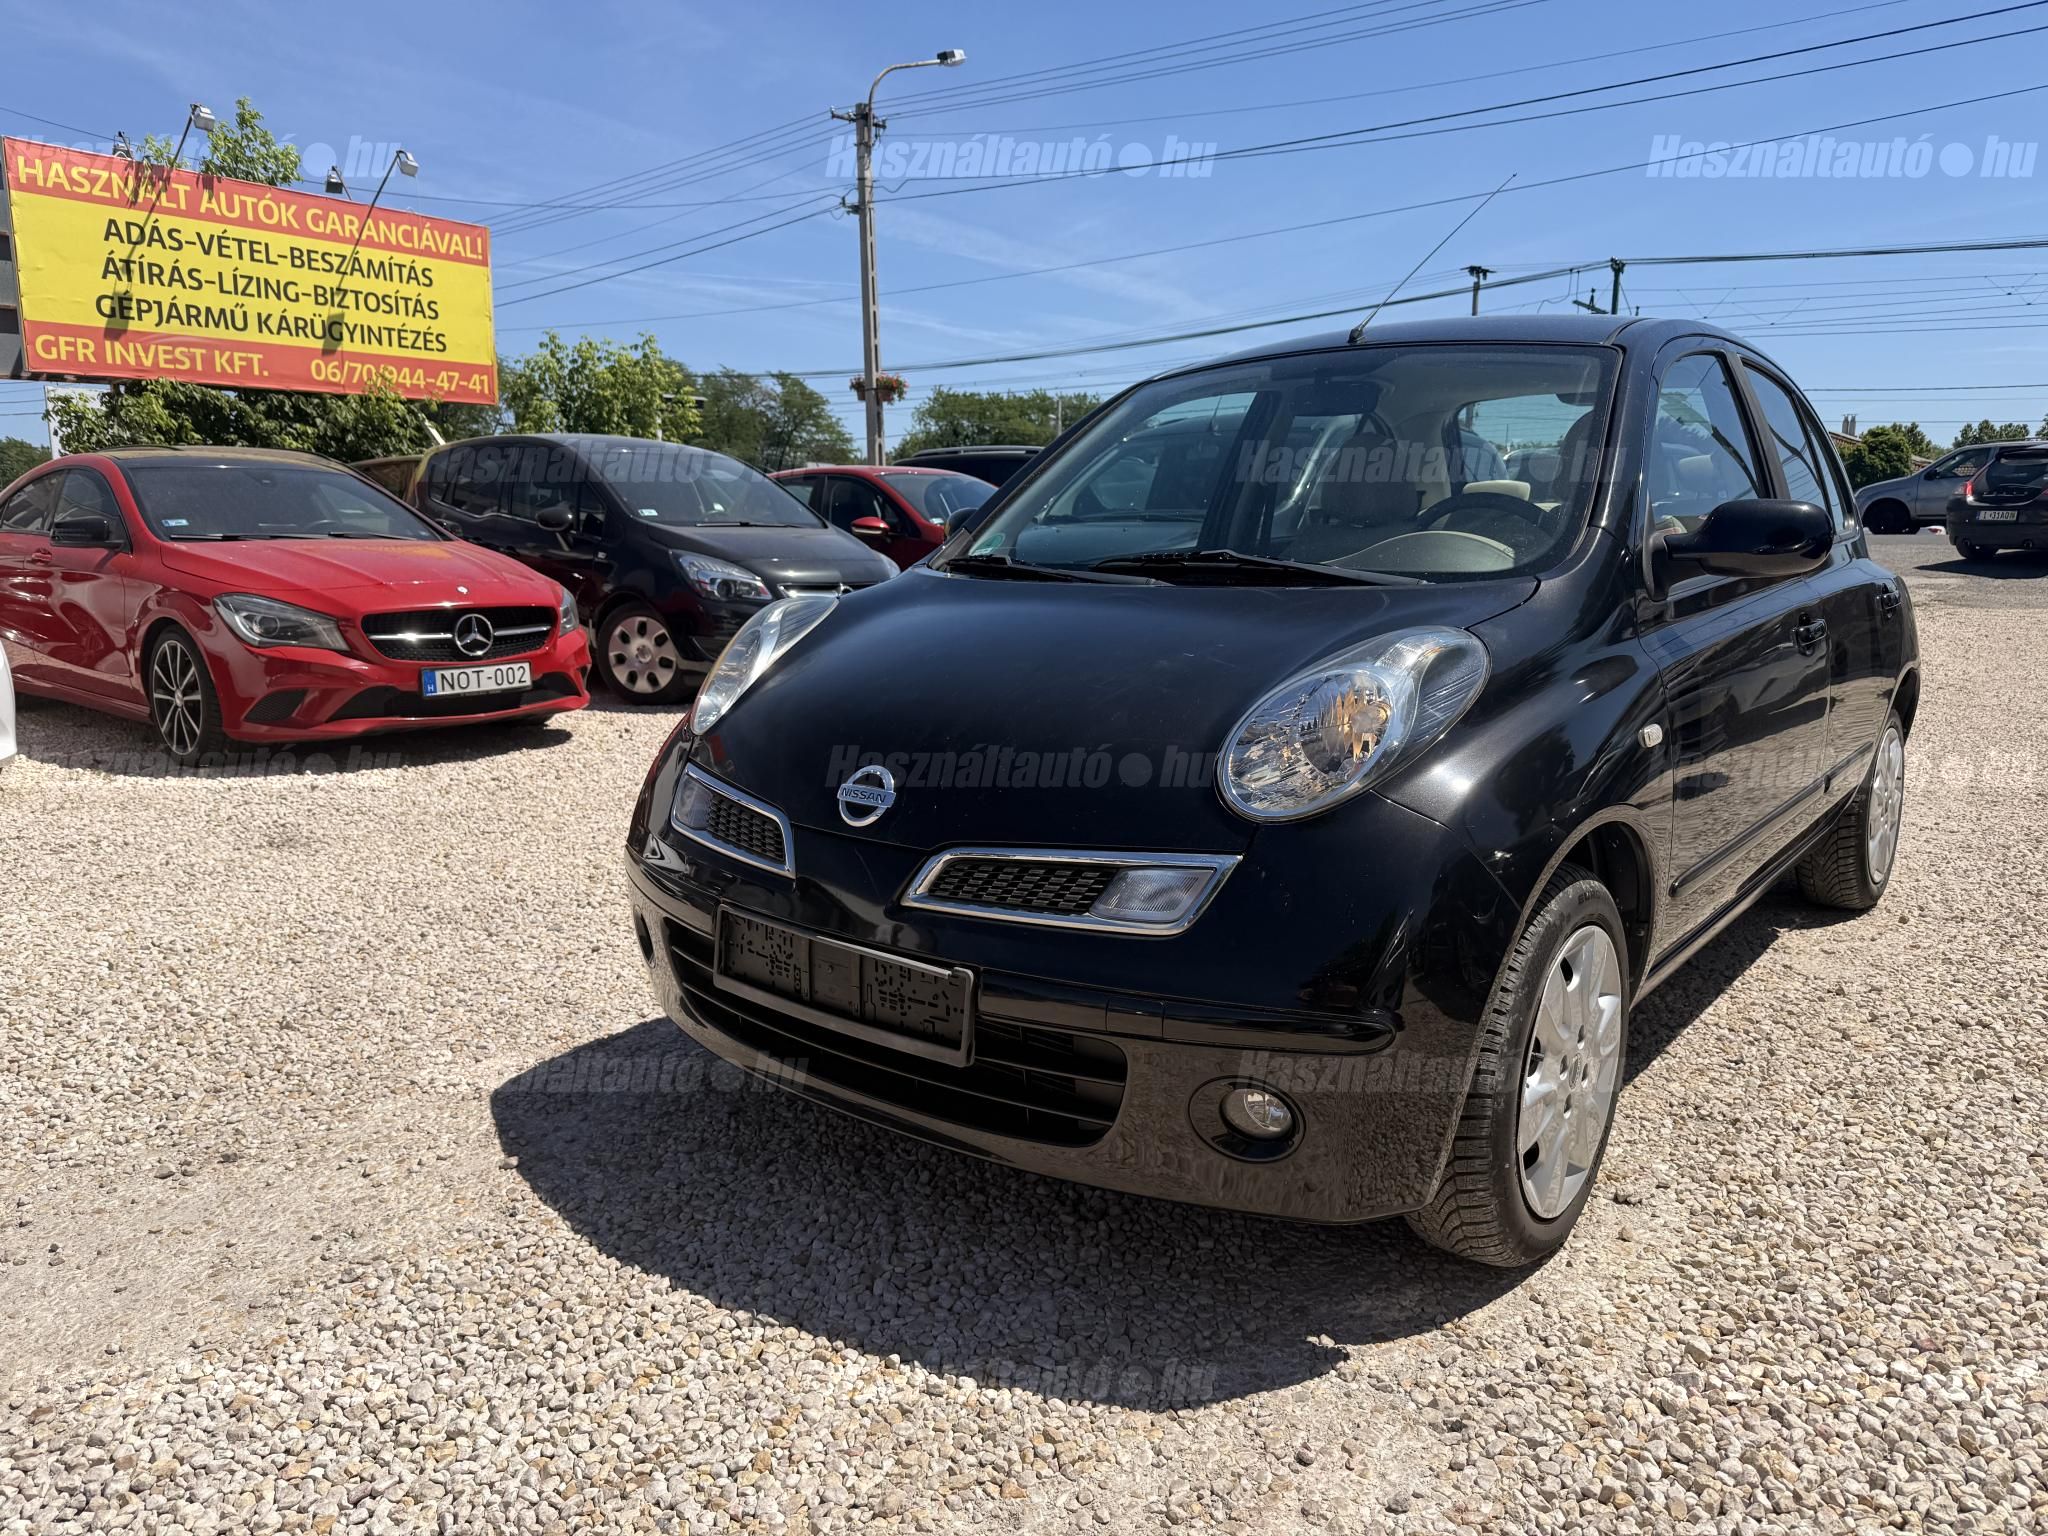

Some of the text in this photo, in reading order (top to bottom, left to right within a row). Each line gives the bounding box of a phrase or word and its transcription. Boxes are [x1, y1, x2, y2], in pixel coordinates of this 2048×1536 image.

[200, 188, 299, 230] AUTÓK
[306, 207, 483, 260] GARANCIÁVAL!
[96, 289, 448, 353] GÉPJÁRMŰ KÁRÜGYINTÉZÉS
[35, 334, 270, 377] GFR INVEST KFT.
[440, 665, 527, 692] NOT-002
[841, 787, 887, 804] NISSAN
